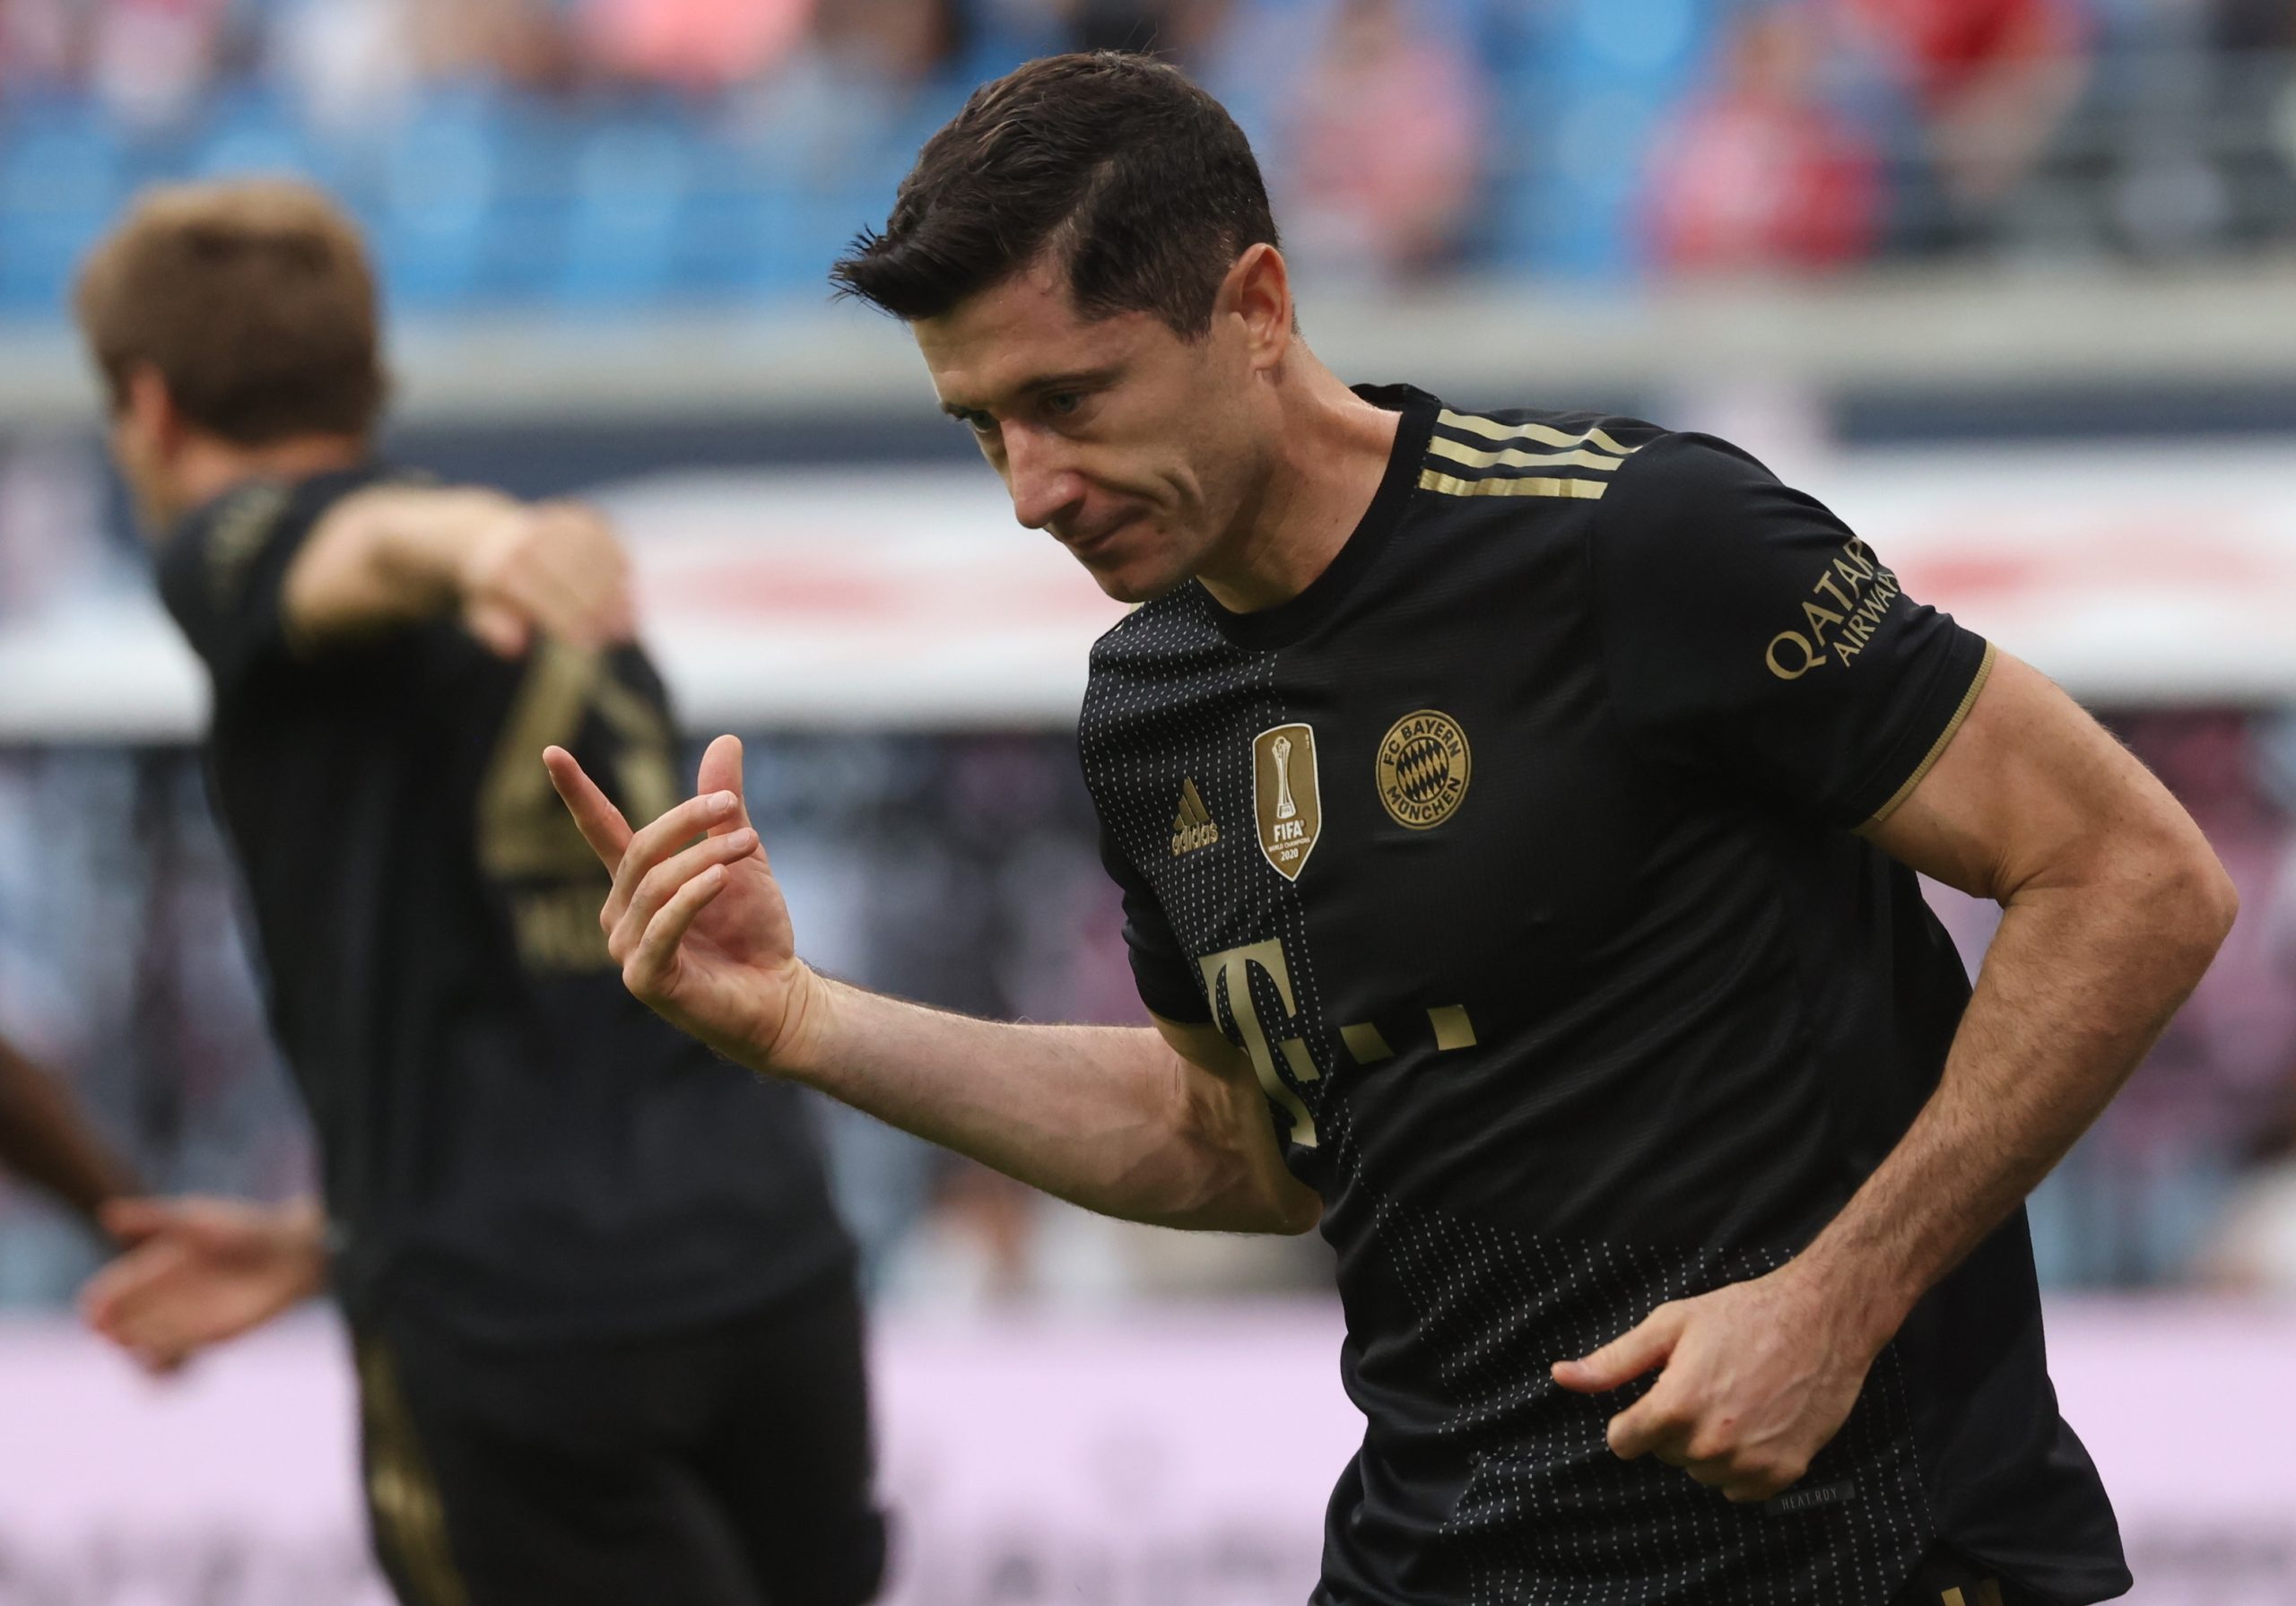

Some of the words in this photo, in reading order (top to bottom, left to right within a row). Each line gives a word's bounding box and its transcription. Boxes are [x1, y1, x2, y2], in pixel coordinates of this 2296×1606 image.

[1765, 535, 1874, 681] QATAR
[1832, 571, 1899, 668] AIRWAY
[1382, 740, 1400, 767] FC
[1401, 718, 1462, 758] BAYERN
[1386, 777, 1462, 820] MÜNCHEN
[1171, 820, 1219, 857] adidas
[1274, 820, 1303, 842] FIFA
[1280, 847, 1300, 862] 2020
[1197, 937, 1319, 1149] T
